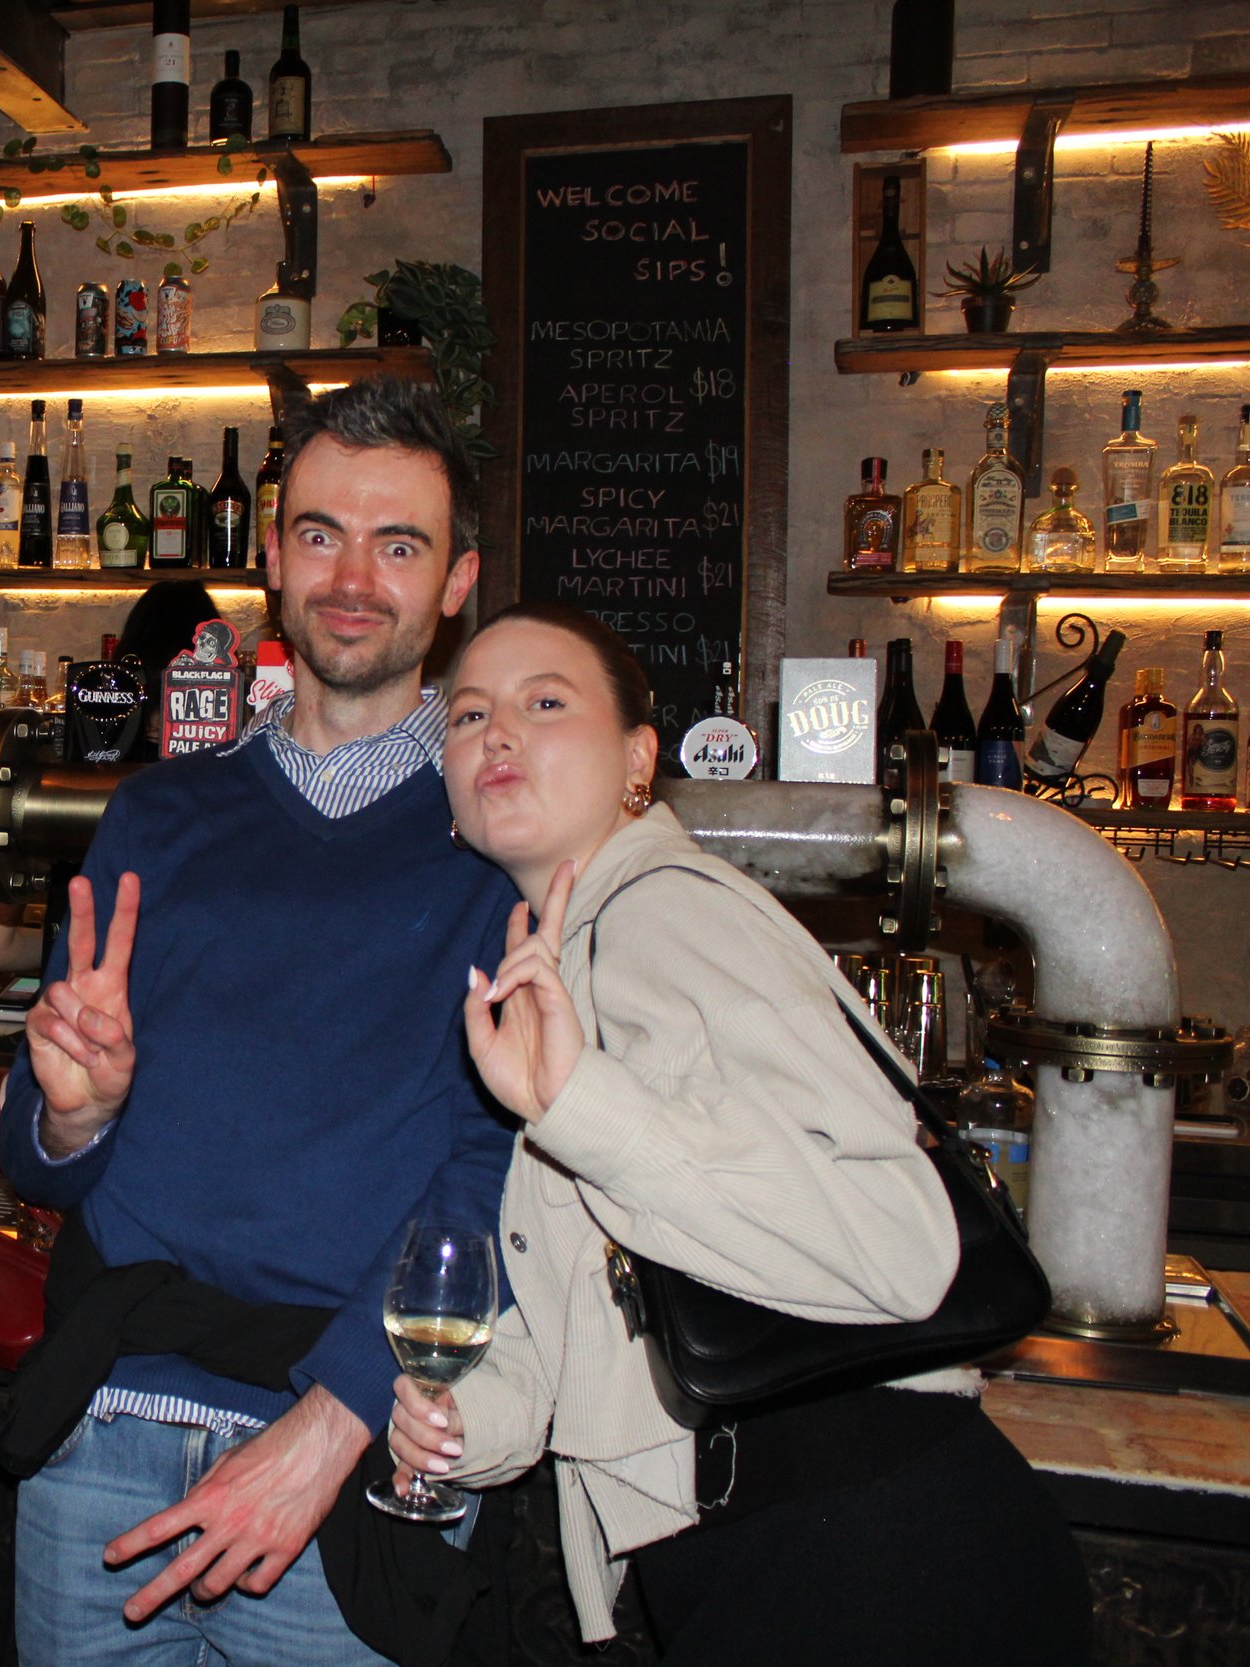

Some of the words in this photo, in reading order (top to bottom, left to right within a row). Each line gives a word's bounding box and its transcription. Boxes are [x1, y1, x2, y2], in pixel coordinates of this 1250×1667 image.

[536, 181, 699, 208] WELCOME
[581, 218, 710, 242] SOCIAL
[531, 317, 731, 343] MESOPOTAMIA
[569, 348, 674, 369] SPRITZ
[558, 384, 683, 404] APEROL
[690, 366, 736, 404] $18
[571, 406, 685, 432] SPRITZ
[526, 451, 701, 474] MARGARITA
[705, 439, 740, 484] $19
[581, 487, 666, 509] SPICY
[1171, 484, 1208, 506] 818
[526, 515, 700, 539] MARGARITA
[703, 496, 739, 539] $21
[1170, 508, 1207, 517] TEQUILA
[1170, 518, 1207, 526] BLANCO
[572, 549, 672, 569] LYCHEE
[557, 574, 686, 598] MARTINI
[698, 555, 732, 596] $21
[588, 611, 696, 632] RESSO
[628, 642, 687, 666] TINI
[695, 633, 730, 673] $21
[78, 688, 135, 704] GUINNESS
[803, 683, 823, 697] PALE
[171, 689, 228, 720] RAGE
[787, 700, 869, 737] DOUG
[169, 740, 200, 753] PALE
[693, 744, 744, 762] Asahi
